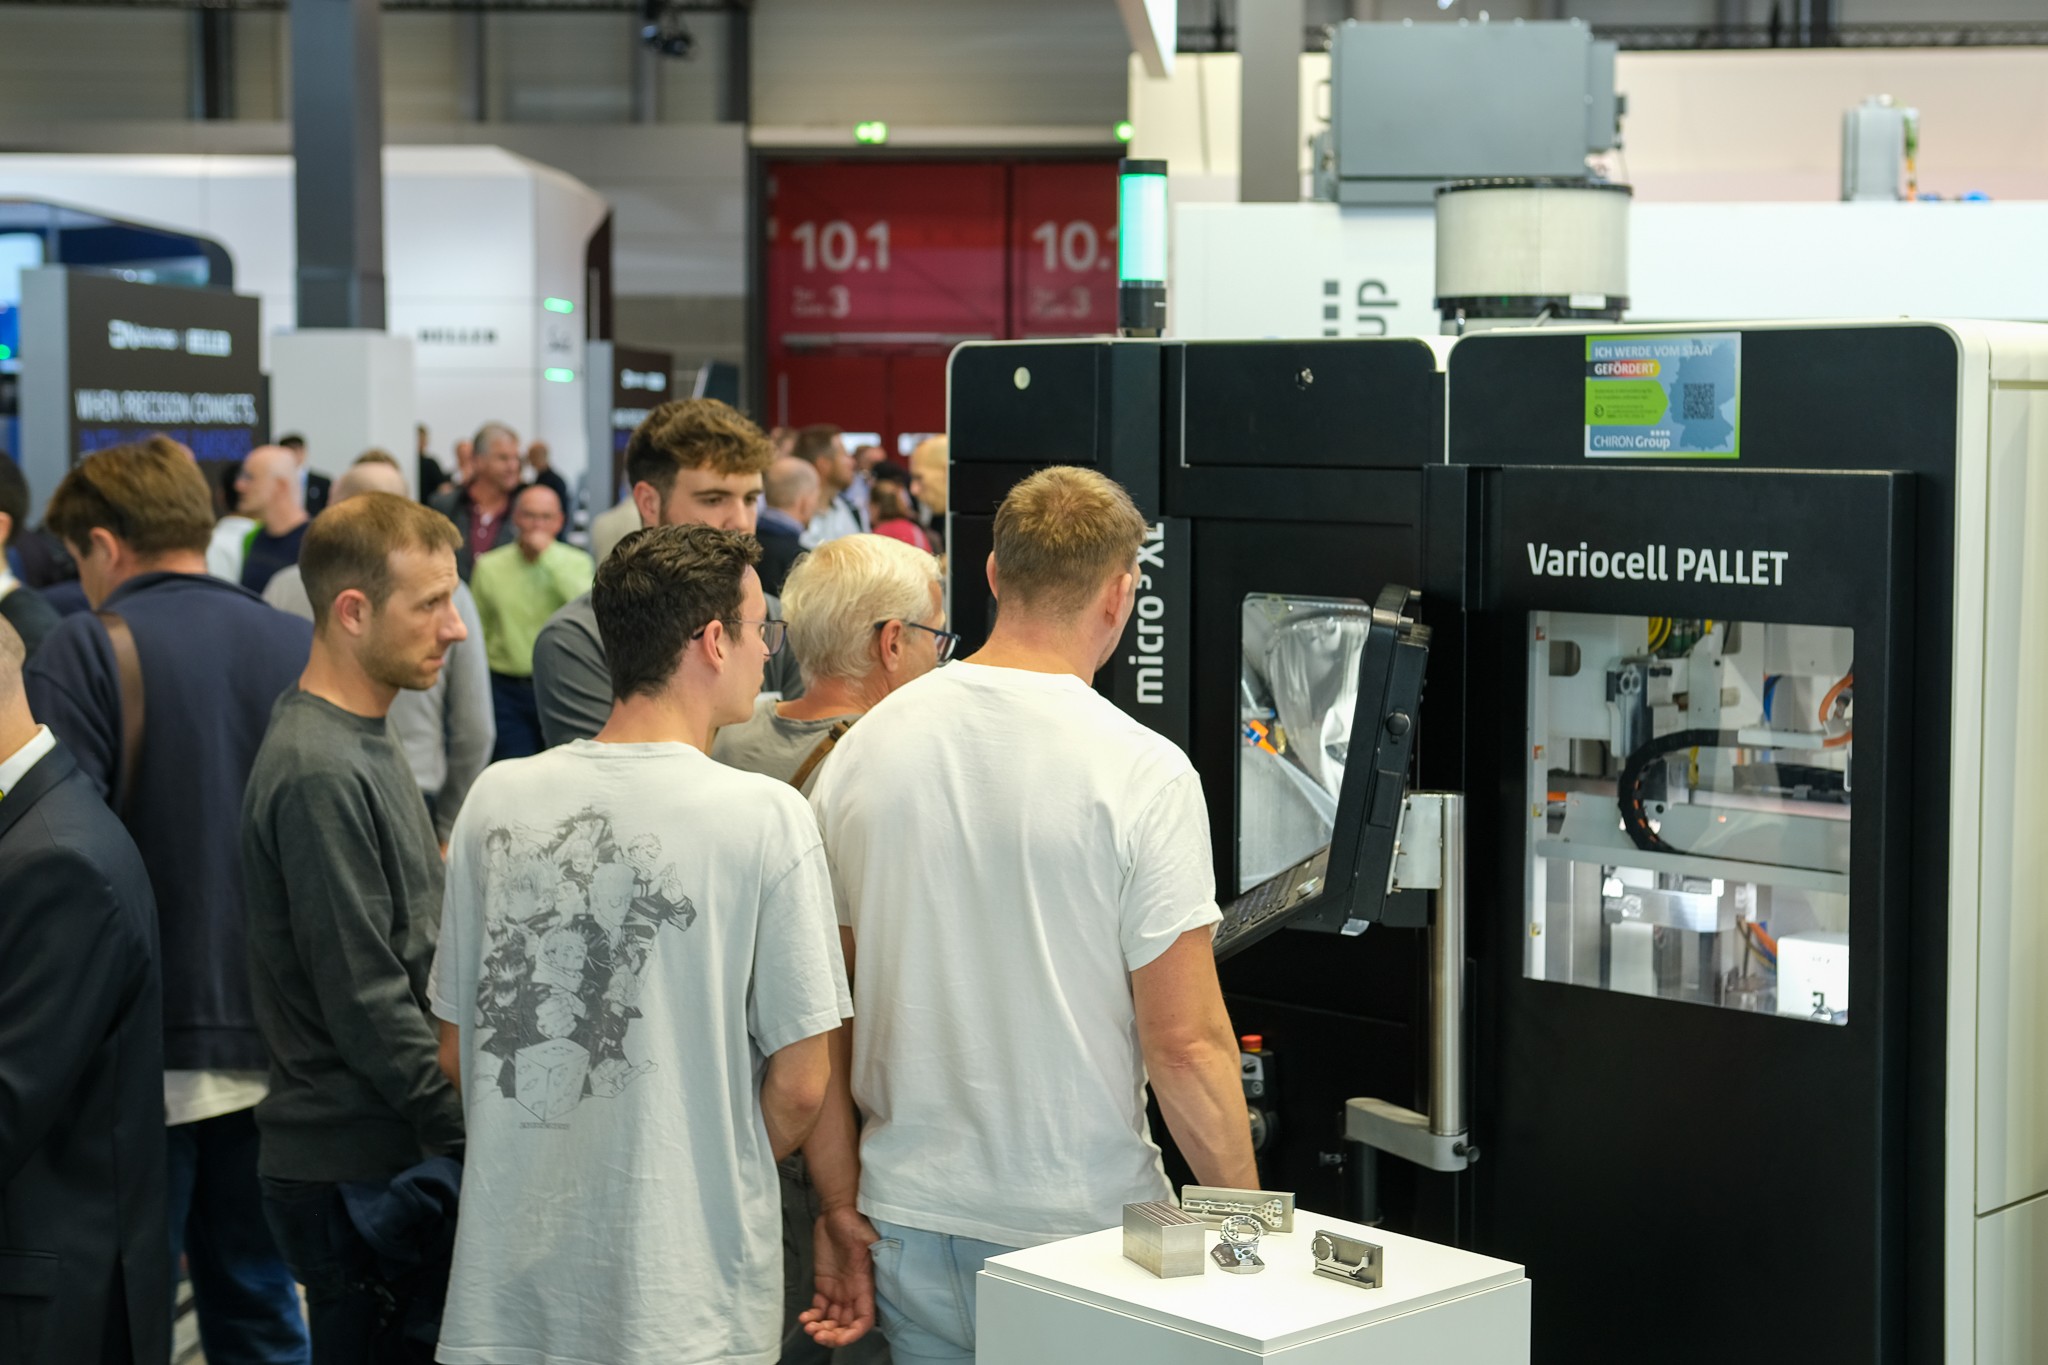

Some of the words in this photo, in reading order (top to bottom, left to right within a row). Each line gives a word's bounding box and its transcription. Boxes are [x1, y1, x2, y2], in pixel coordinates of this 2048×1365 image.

[791, 219, 891, 272] 10.1
[1594, 346, 1612, 358] ICH
[1615, 345, 1651, 358] WERDE
[1654, 345, 1680, 357] VOM
[1682, 345, 1714, 357] STAAT
[1594, 362, 1655, 376] GEFÖRDERT
[1593, 435, 1634, 448] CHIRON
[1635, 435, 1671, 450] Group
[1526, 541, 1669, 582] Variocell
[1677, 547, 1789, 586] PALLET
